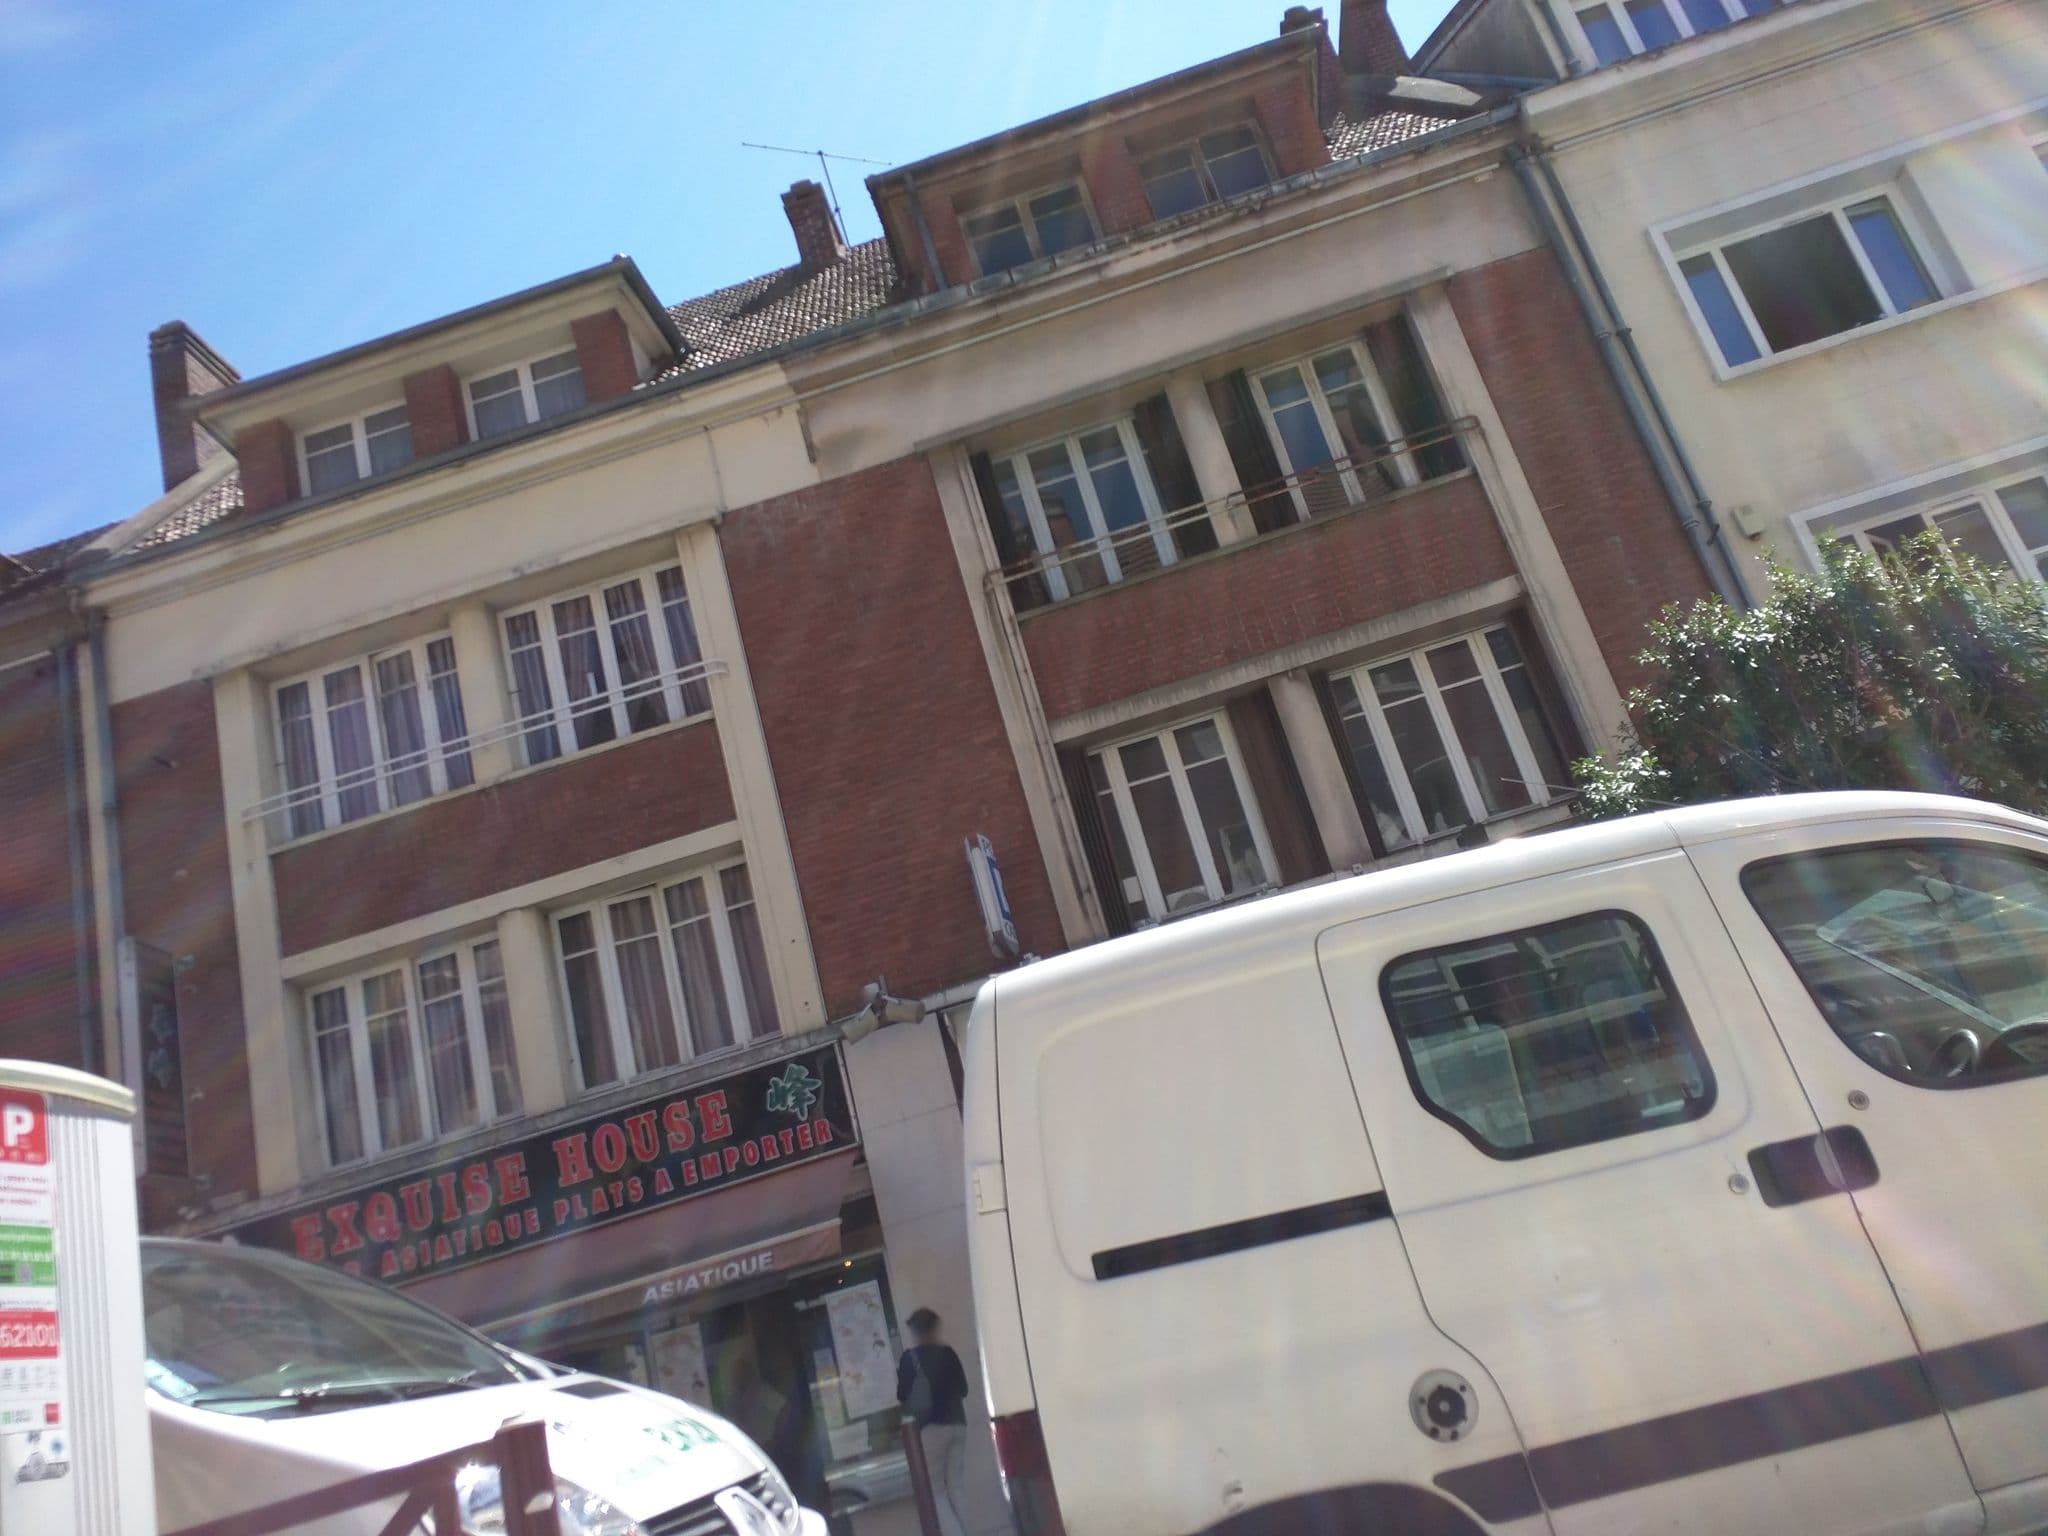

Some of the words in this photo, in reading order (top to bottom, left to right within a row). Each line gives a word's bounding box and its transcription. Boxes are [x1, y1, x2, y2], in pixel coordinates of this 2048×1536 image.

[4, 1105, 35, 1147] P
[290, 1152, 530, 1263] EXQUISE
[553, 1089, 733, 1187] HOUSE
[380, 1207, 541, 1278] ASIATIQUE
[553, 1176, 643, 1225] PLATS
[655, 1168, 674, 1195] A
[682, 1118, 833, 1186] EMPORTER
[641, 1251, 775, 1305] ASIATIQUE
